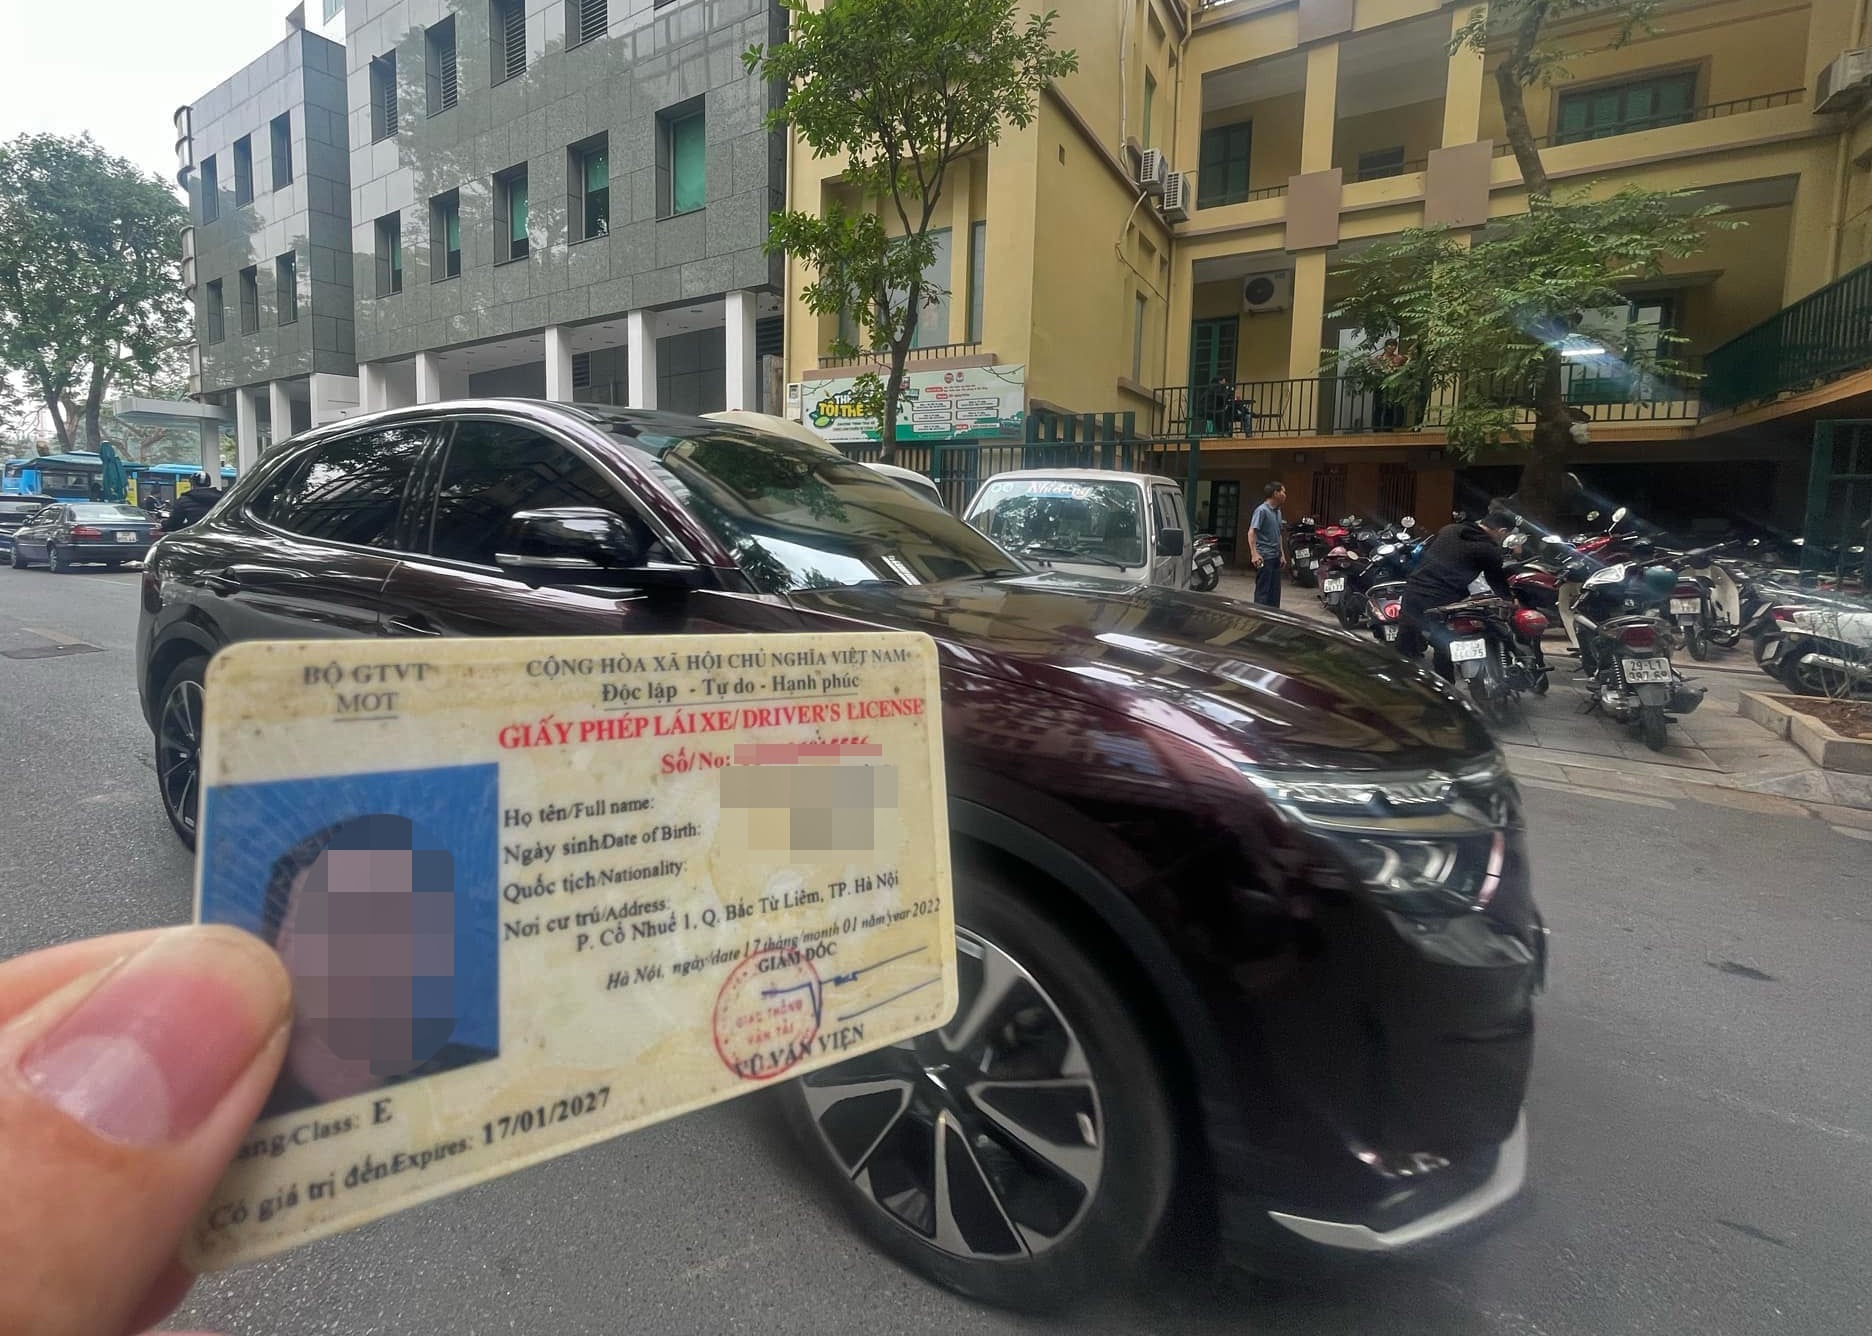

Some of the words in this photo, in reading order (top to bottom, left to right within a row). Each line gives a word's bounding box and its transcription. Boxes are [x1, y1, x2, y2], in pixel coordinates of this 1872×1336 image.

[304, 661, 343, 688] BỘ
[351, 662, 430, 683] GTVT
[526, 655, 594, 680] CỘNG
[600, 652, 648, 674] HÒA
[654, 652, 680, 672] XÃ
[687, 650, 723, 674] HỘI
[728, 648, 767, 669] CHỦ
[771, 648, 827, 666] NGHĨA
[832, 647, 869, 667] VIỆT
[872, 648, 907, 664] NAM
[335, 691, 400, 713] MOT
[602, 683, 641, 705] Độc
[648, 681, 678, 704] lập
[702, 678, 730, 700] Tự
[734, 678, 755, 694] do
[772, 673, 816, 695] Hạnh
[822, 672, 859, 693] phúc
[498, 714, 574, 749] GIẤY
[579, 711, 649, 743] PHÉP
[653, 708, 696, 736] LÁI
[847, 697, 926, 721] LICENSE
[504, 808, 533, 828] Họ
[610, 797, 655, 816] name:
[504, 843, 556, 867] Ngày
[642, 827, 658, 844] of
[661, 821, 702, 842] Birth:
[503, 874, 557, 904] Quốc
[576, 934, 595, 952] P.
[600, 921, 626, 946] Cổ
[702, 908, 721, 929] Q.
[726, 899, 753, 923] Bắc
[759, 896, 779, 915] Từ
[828, 881, 851, 900] TP.
[855, 873, 873, 895] Hà
[877, 870, 899, 890] Nội
[504, 918, 541, 941] Nơi
[546, 915, 571, 933] cư
[606, 971, 629, 990] Hà
[842, 915, 858, 935] 01
[912, 897, 941, 918] 2022
[758, 948, 801, 973] GIÁM
[818, 1024, 864, 1053] VIỆN
[370, 1098, 393, 1125] E
[482, 1086, 611, 1146] 17/01/2027
